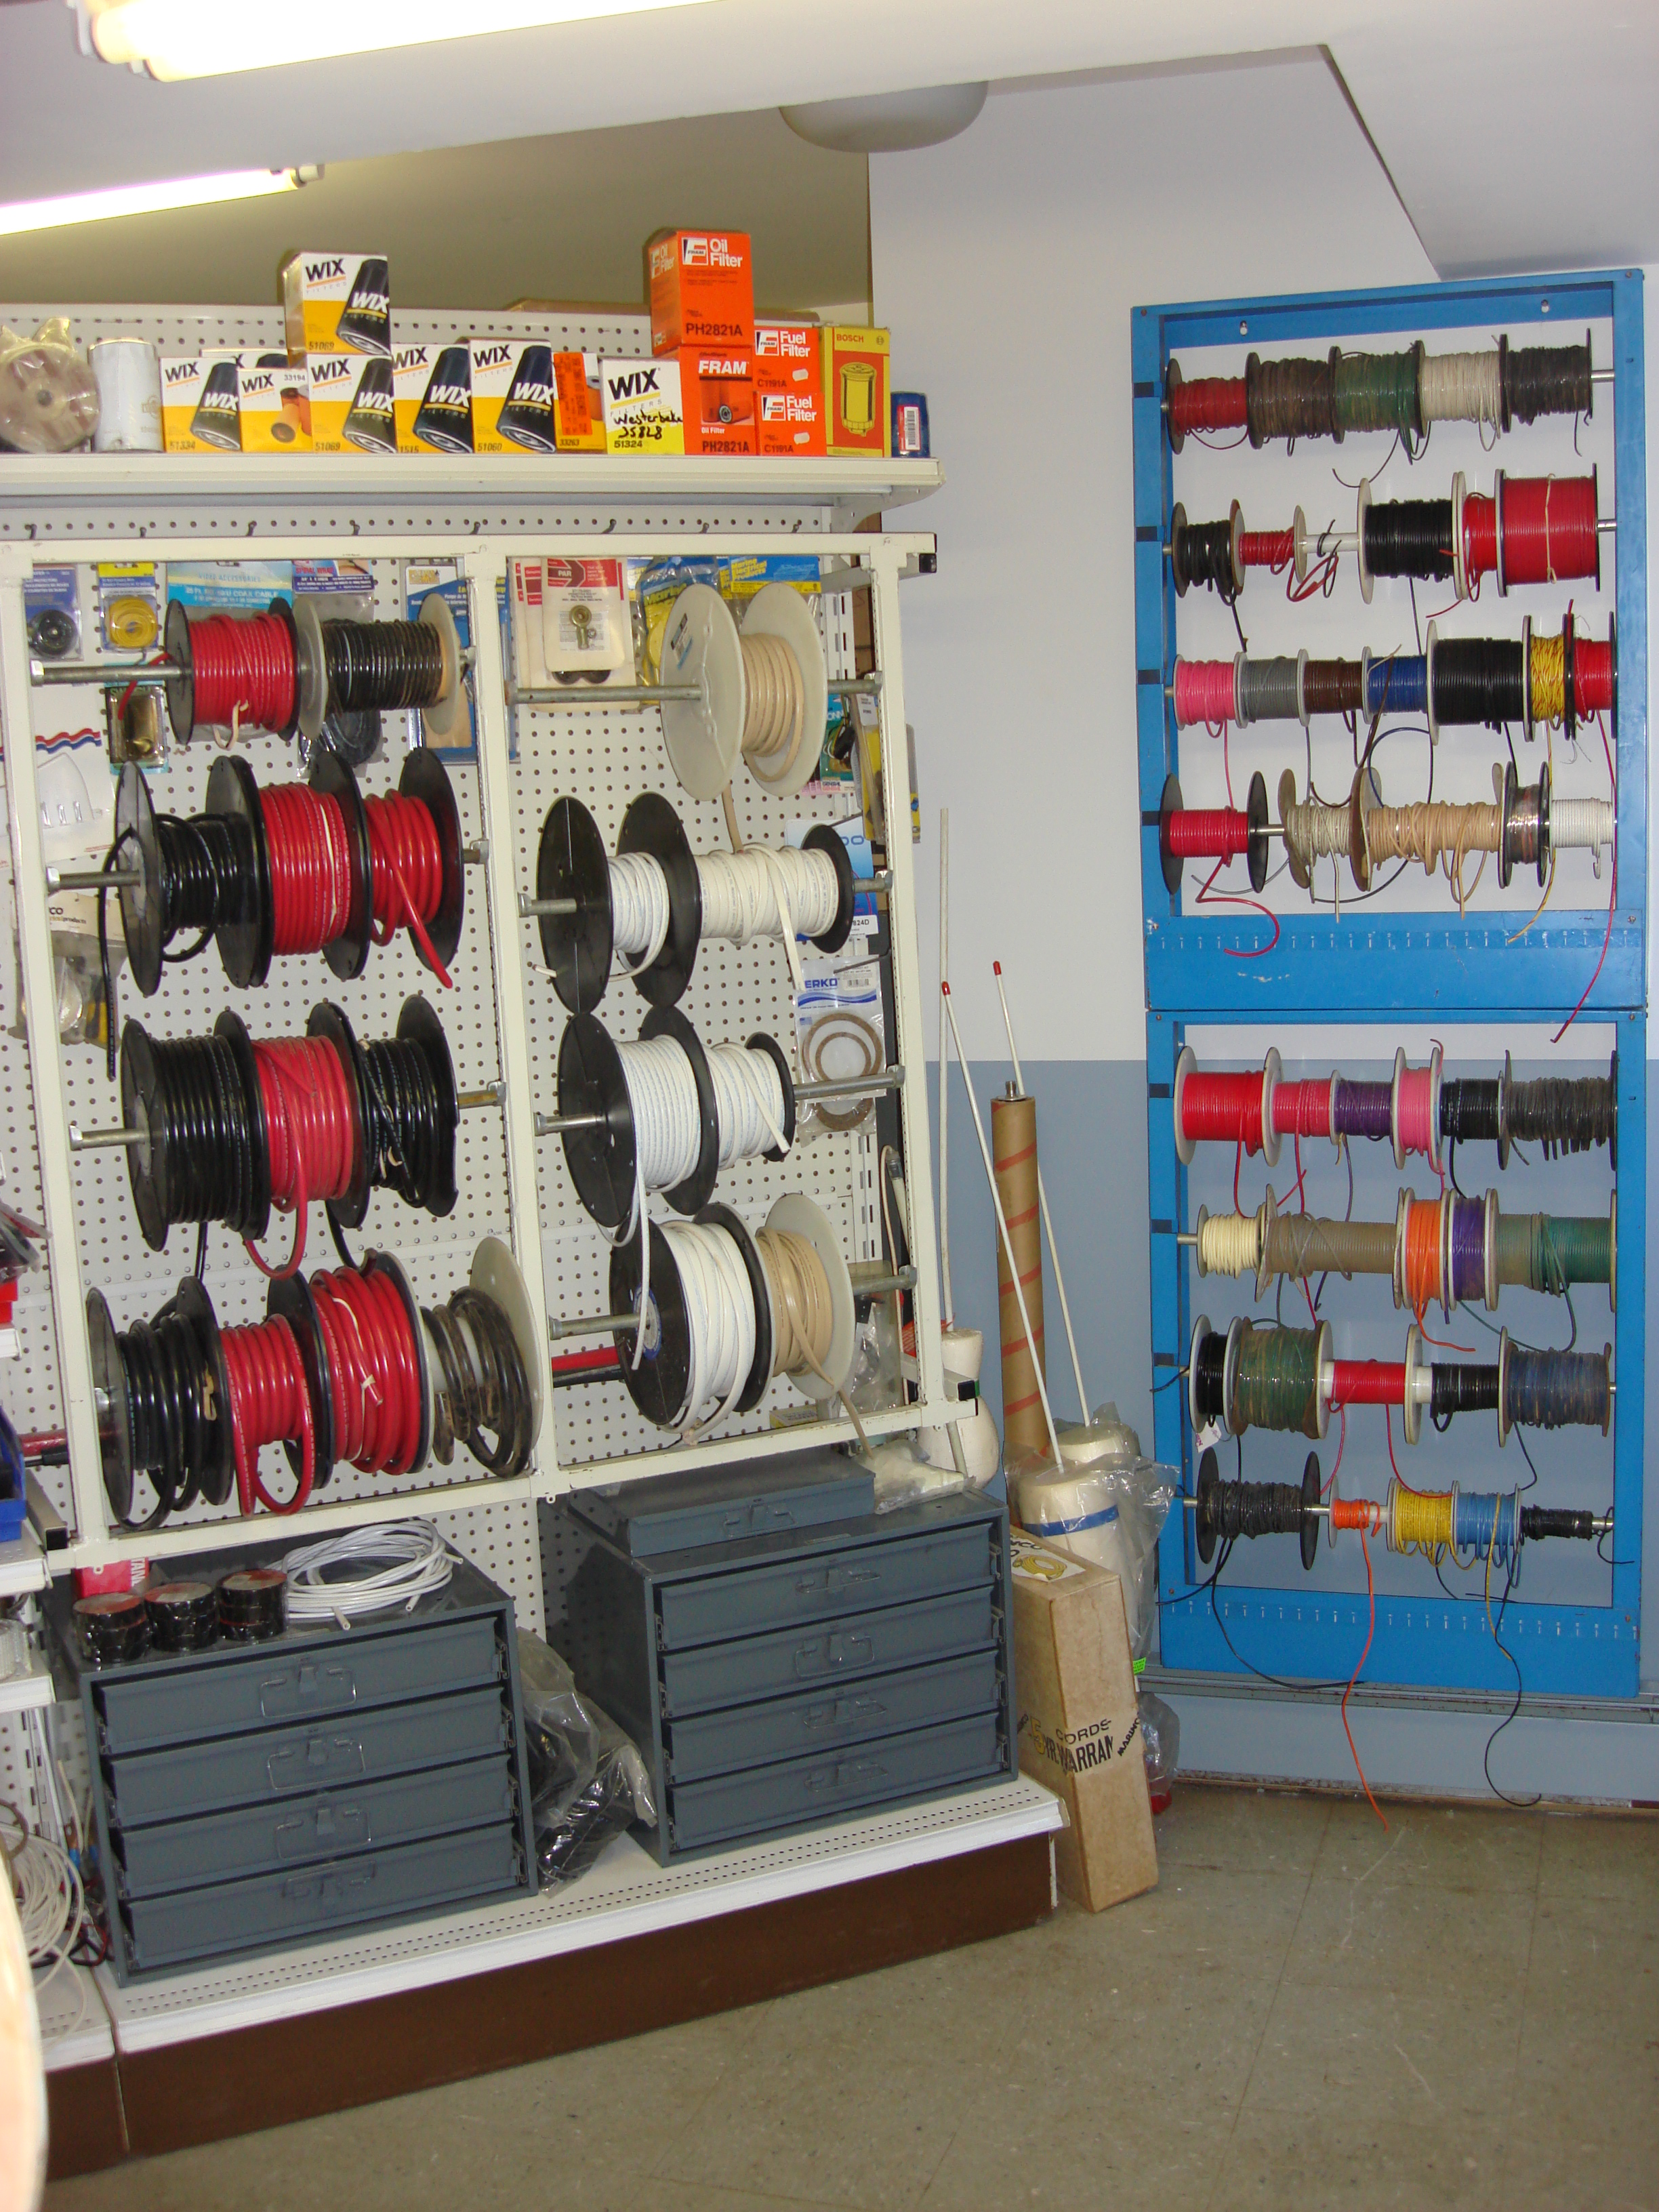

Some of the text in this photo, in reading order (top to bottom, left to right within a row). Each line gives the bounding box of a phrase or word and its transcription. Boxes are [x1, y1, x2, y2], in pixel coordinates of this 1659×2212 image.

[710, 239, 727, 253] Oil
[710, 252, 743, 268] Filter
[306, 258, 346, 282] WIX
[352, 291, 390, 314] WIX
[686, 323, 743, 336] PH2821A
[780, 331, 806, 344] Fuel
[836, 333, 864, 343] BOSCH
[393, 346, 429, 370] WIX
[473, 344, 512, 368] WIX
[781, 344, 811, 358] Filter
[165, 361, 201, 382] WIX
[311, 359, 352, 383] WIX
[699, 360, 747, 375] FRAM
[242, 373, 274, 393] WIX
[608, 368, 660, 401] WIX
[204, 392, 239, 411] WIX
[358, 392, 395, 413] WIX
[429, 385, 472, 408] WIX
[514, 382, 554, 406] WIX
[787, 396, 813, 409] Fuel
[610, 399, 663, 417] FILTERS
[787, 409, 817, 422] Filter
[399, 445, 419, 453] 1515
[614, 441, 642, 449] 51324
[702, 441, 750, 453] PH2821A
[804, 978, 838, 989] ERKO
